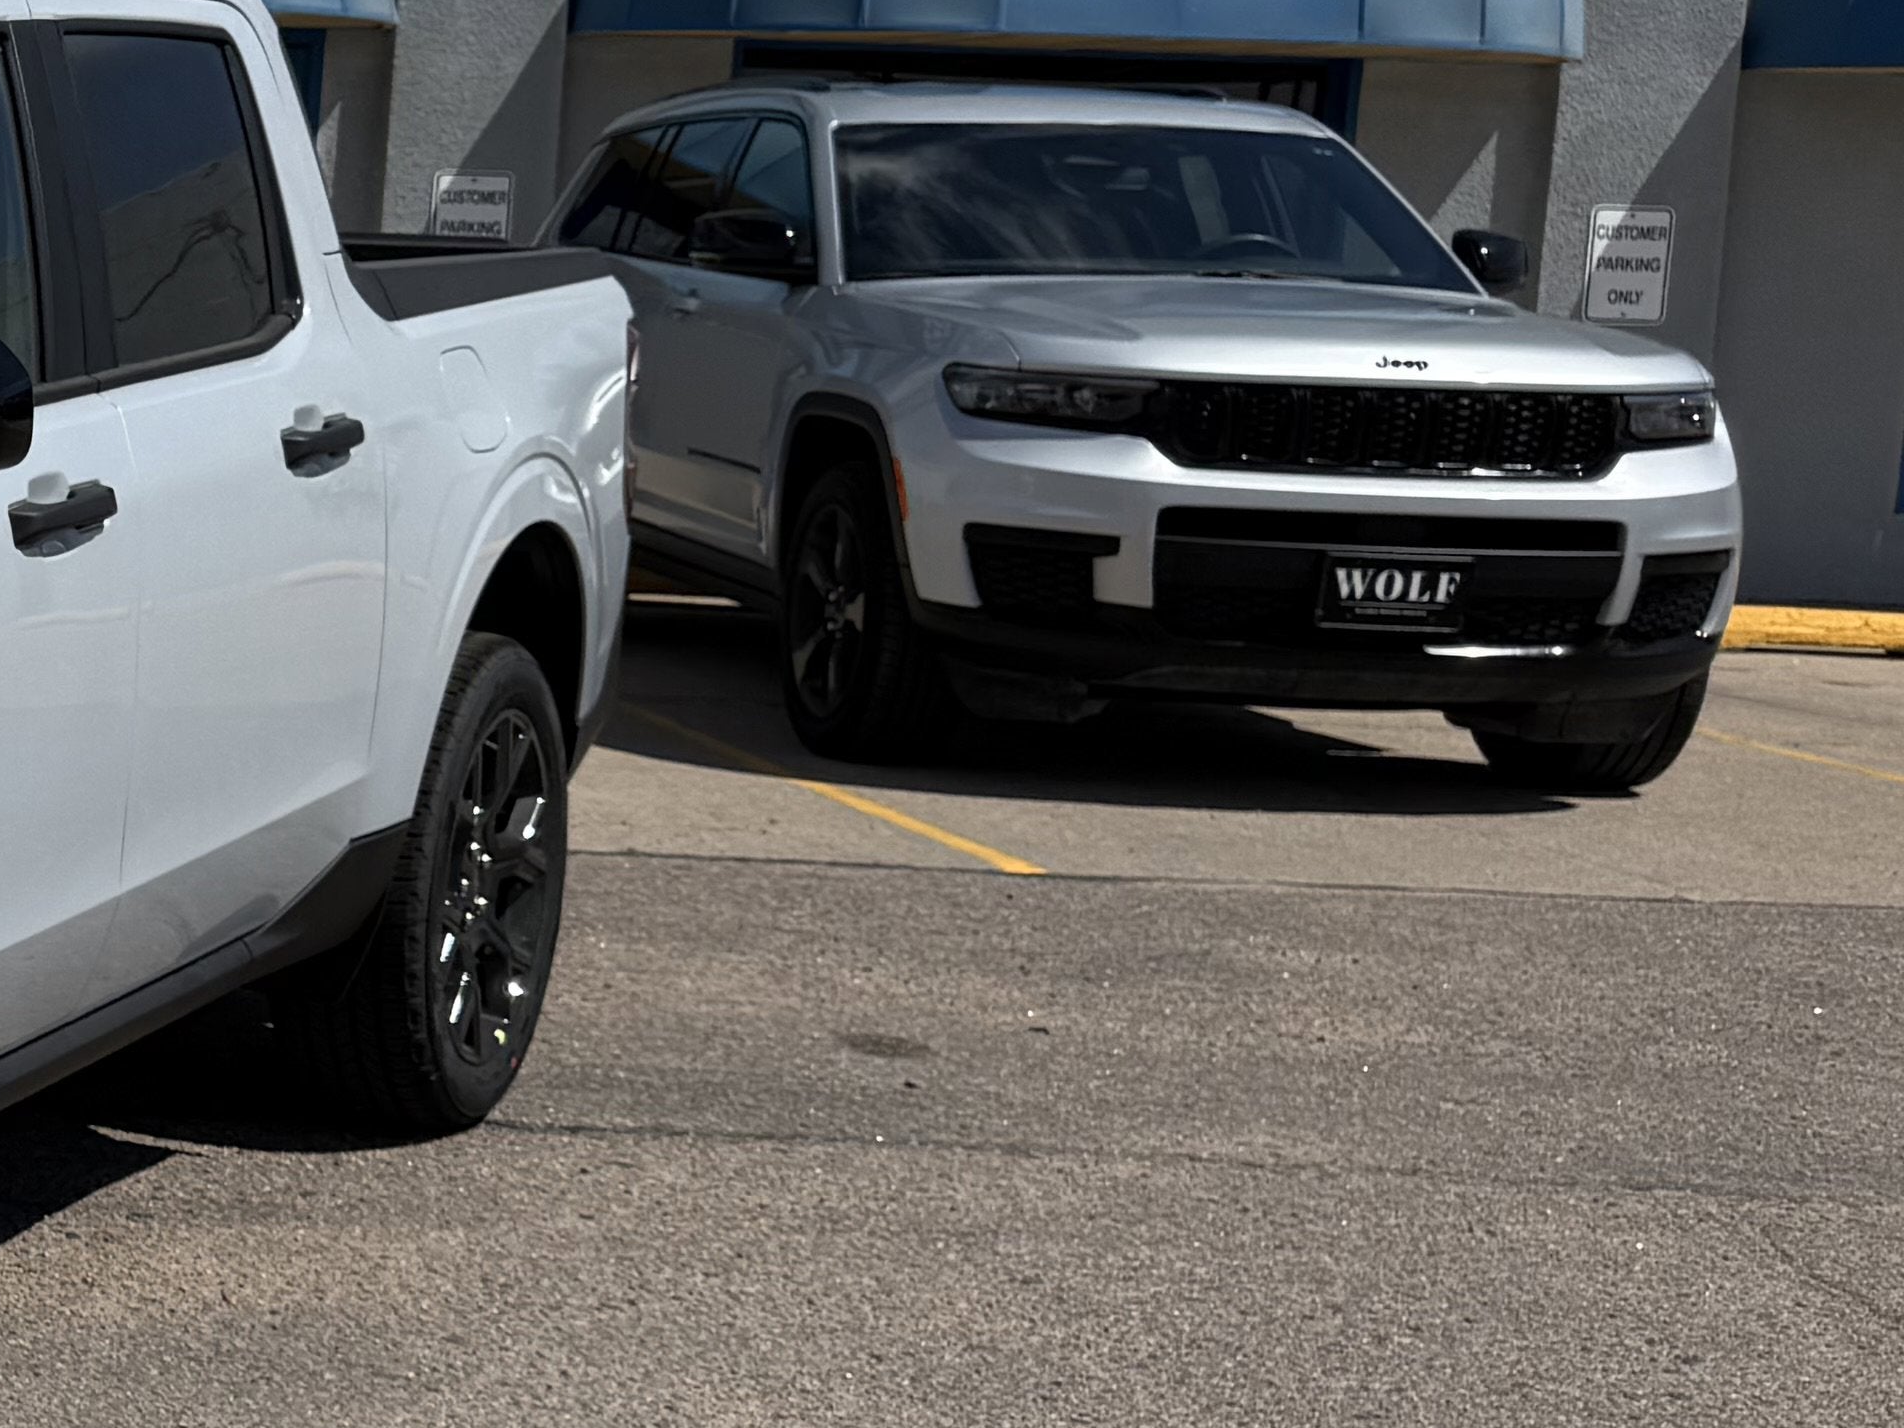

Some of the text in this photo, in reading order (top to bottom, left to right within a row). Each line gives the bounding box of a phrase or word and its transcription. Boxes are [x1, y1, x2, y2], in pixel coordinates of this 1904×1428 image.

[439, 189, 506, 205] CUSTOMER
[439, 219, 502, 235] PARKING
[1596, 223, 1667, 241] CUSTOMER
[1596, 255, 1661, 273] PARKING
[1607, 288, 1643, 305] ONLY
[1375, 355, 1428, 371] Jeep
[1334, 566, 1461, 604] WOLF
